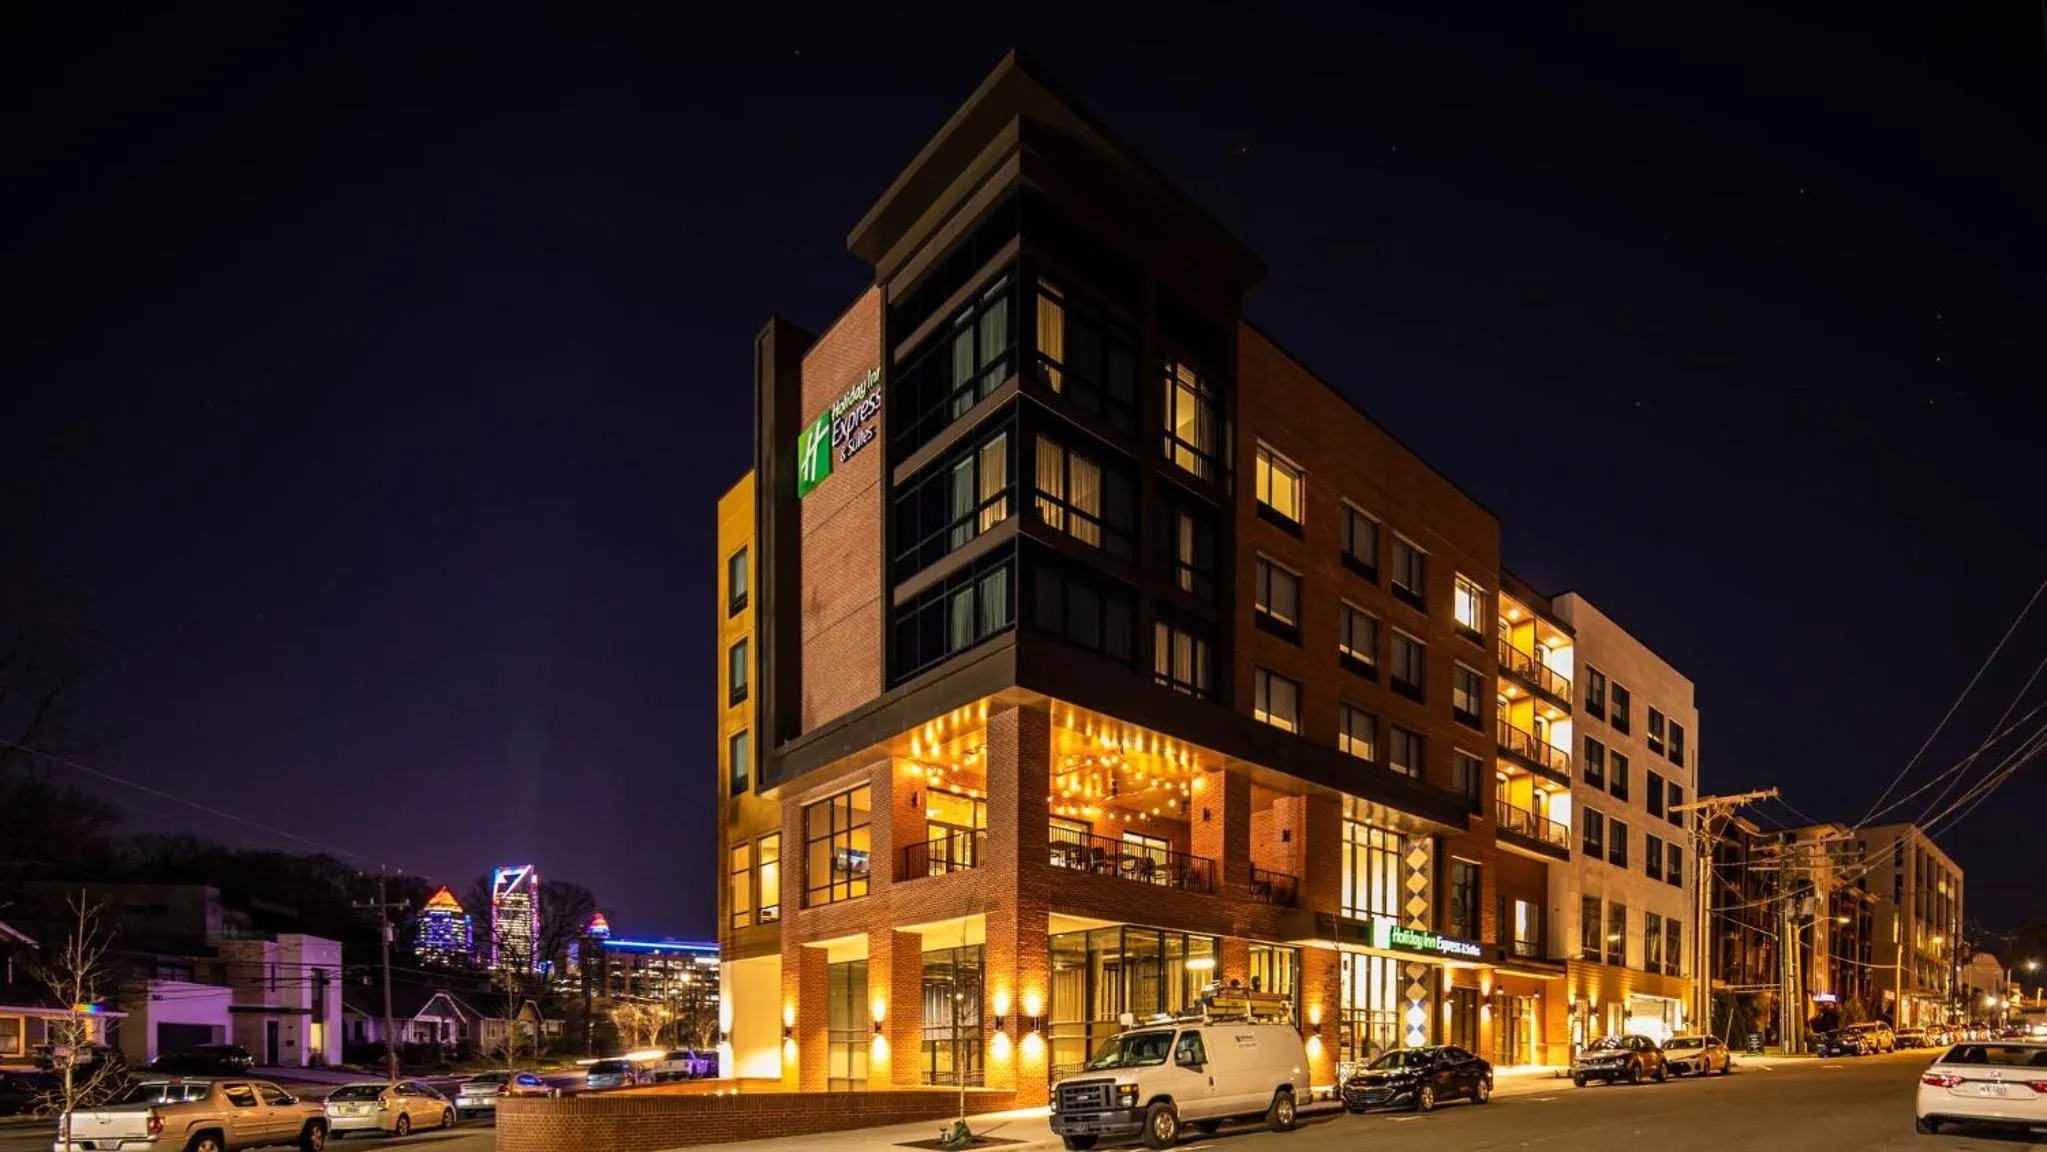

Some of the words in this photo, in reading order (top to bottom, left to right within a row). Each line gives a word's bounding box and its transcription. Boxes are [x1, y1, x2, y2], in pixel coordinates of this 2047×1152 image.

[832, 379, 867, 421] Holiday
[832, 387, 881, 447] Express
[848, 427, 873, 455] Suites
[1392, 927, 1423, 949] Holiday
[1424, 931, 1437, 948] Inn
